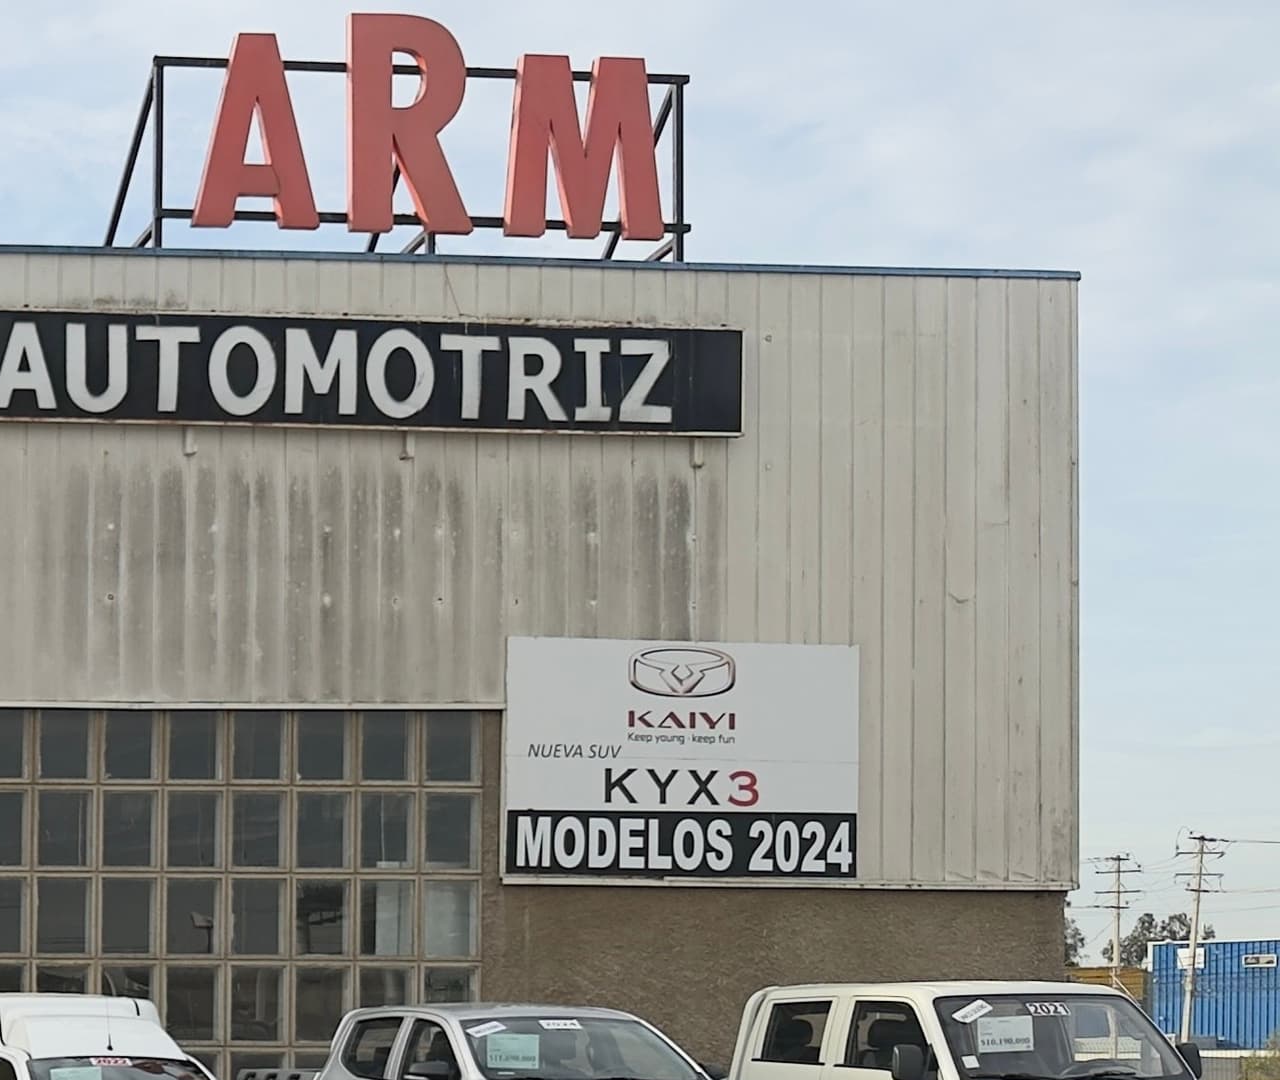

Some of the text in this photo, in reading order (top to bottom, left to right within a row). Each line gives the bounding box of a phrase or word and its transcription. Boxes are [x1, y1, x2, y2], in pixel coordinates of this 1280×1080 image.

[190, 11, 665, 240] ARM
[627, 709, 737, 731] KAIYI
[627, 732, 736, 746] Keep young keep fun
[527, 743, 623, 760] NUEVA SUV
[603, 767, 760, 808] KYX3
[515, 815, 854, 874] MODELOS 2024
[1026, 1003, 1071, 1016] 2021
